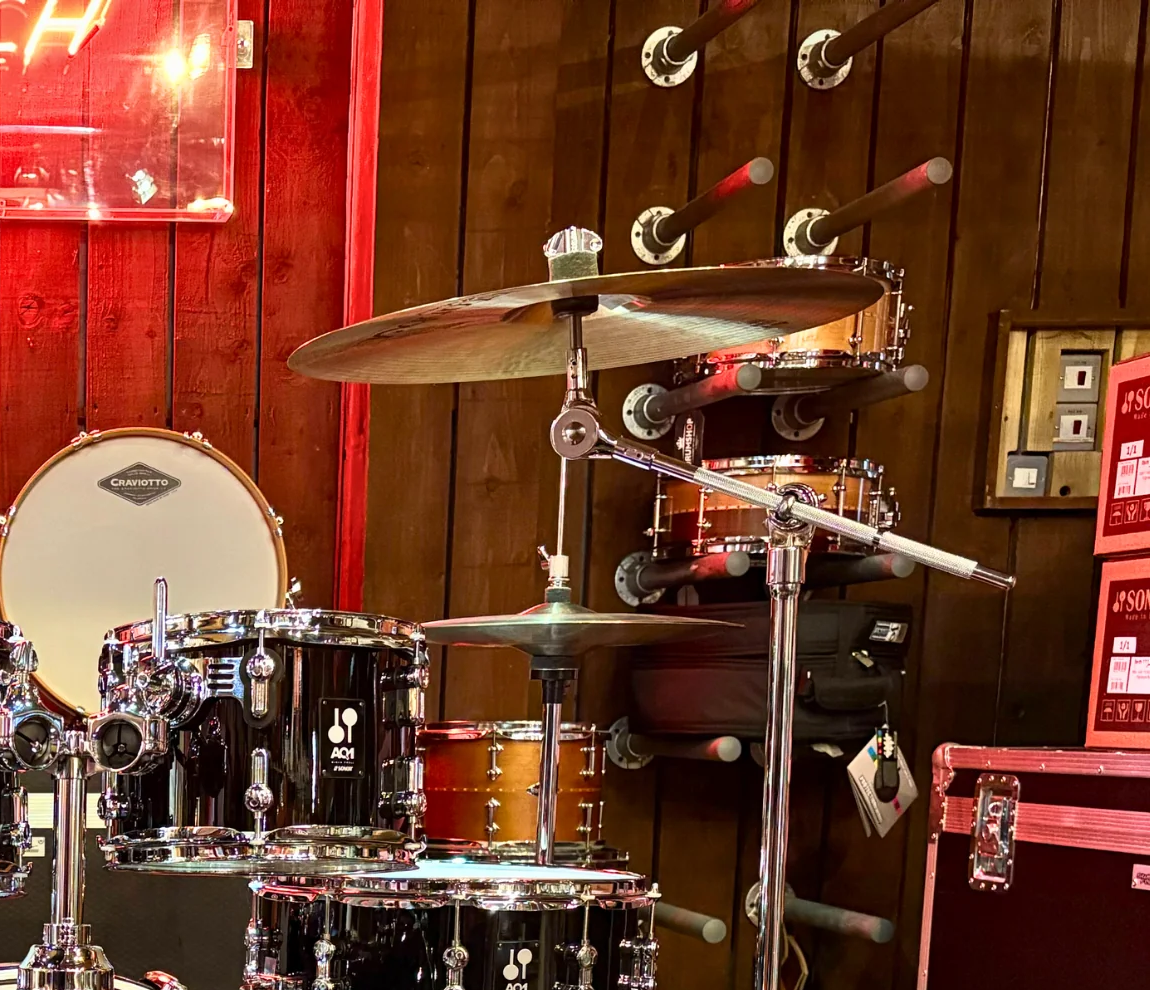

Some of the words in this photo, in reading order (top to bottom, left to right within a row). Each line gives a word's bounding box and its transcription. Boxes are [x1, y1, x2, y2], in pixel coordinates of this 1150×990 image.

[1126, 443, 1138, 456] 1/1
[110, 478, 169, 487] CRAVIOTTO
[1119, 639, 1130, 651] 1/1
[330, 746, 355, 761] AQ1
